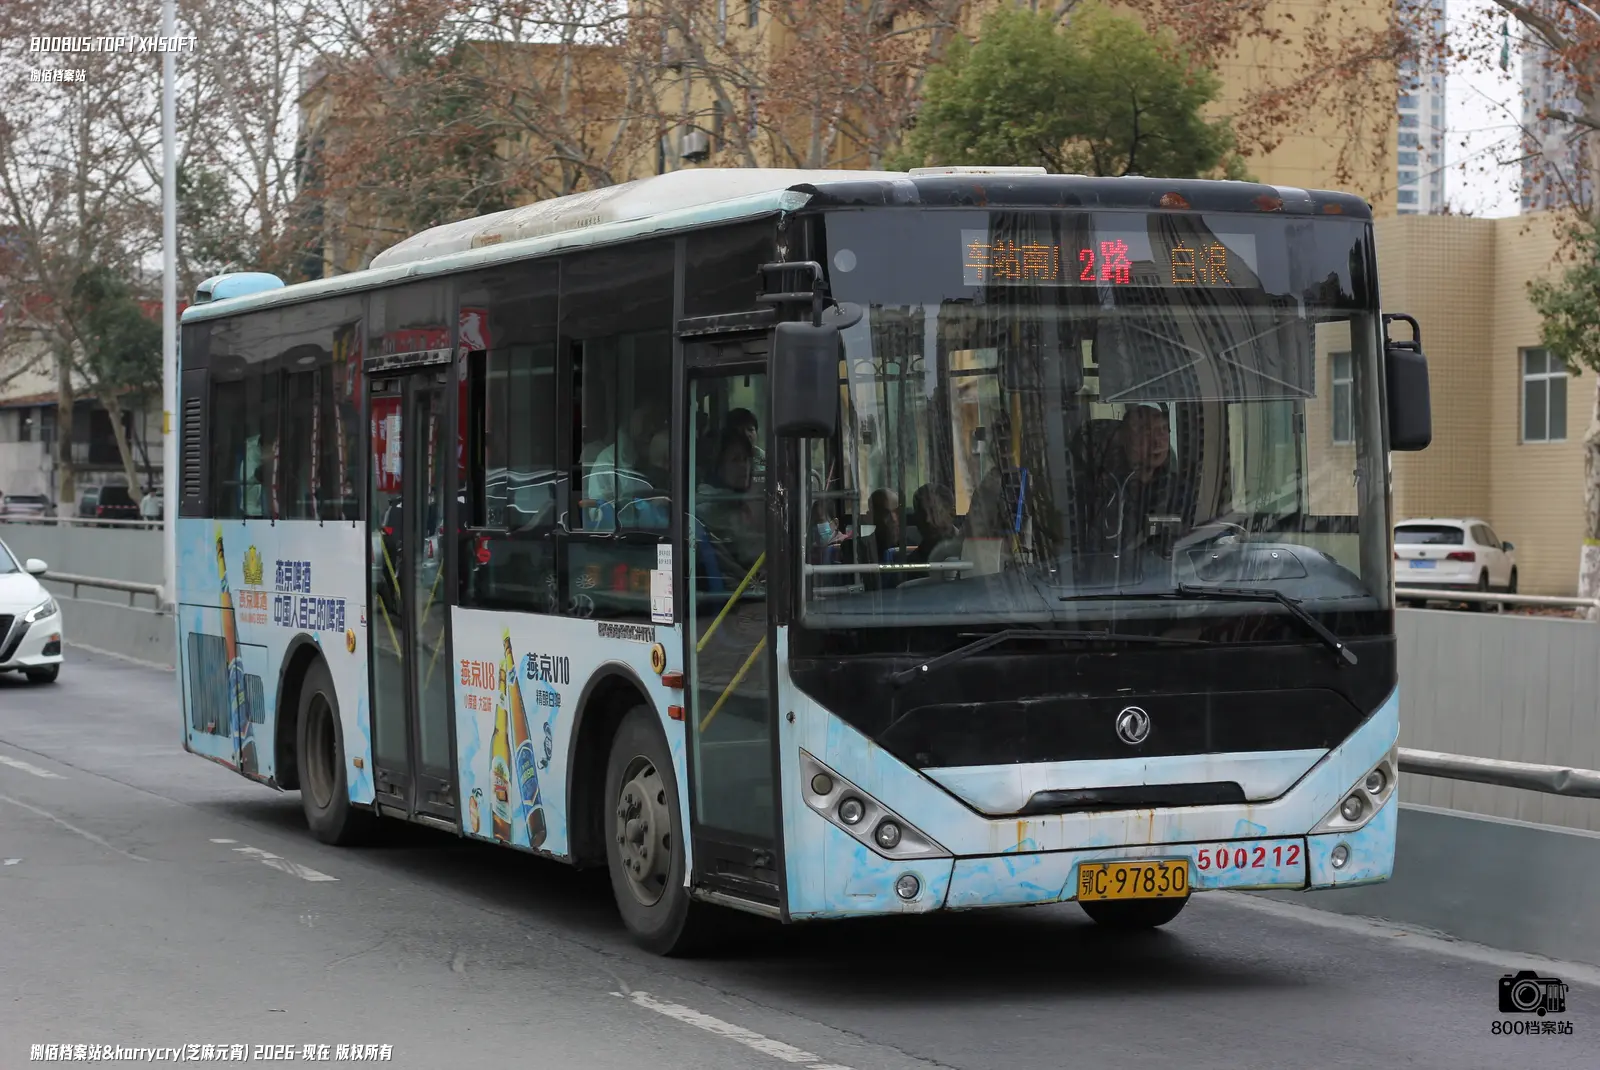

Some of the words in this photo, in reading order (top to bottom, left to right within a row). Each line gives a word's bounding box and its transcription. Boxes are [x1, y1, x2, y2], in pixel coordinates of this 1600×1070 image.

[965, 239, 1059, 280] 车站南
[1079, 239, 1132, 285] 2路
[1171, 240, 1231, 285] 白浪
[275, 559, 311, 593] 燕京啤酒
[274, 594, 346, 633] 中国人自己的啤酒
[460, 658, 495, 691] 燕京U8
[526, 652, 570, 685] 燕京V10
[1197, 844, 1301, 871] 500212
